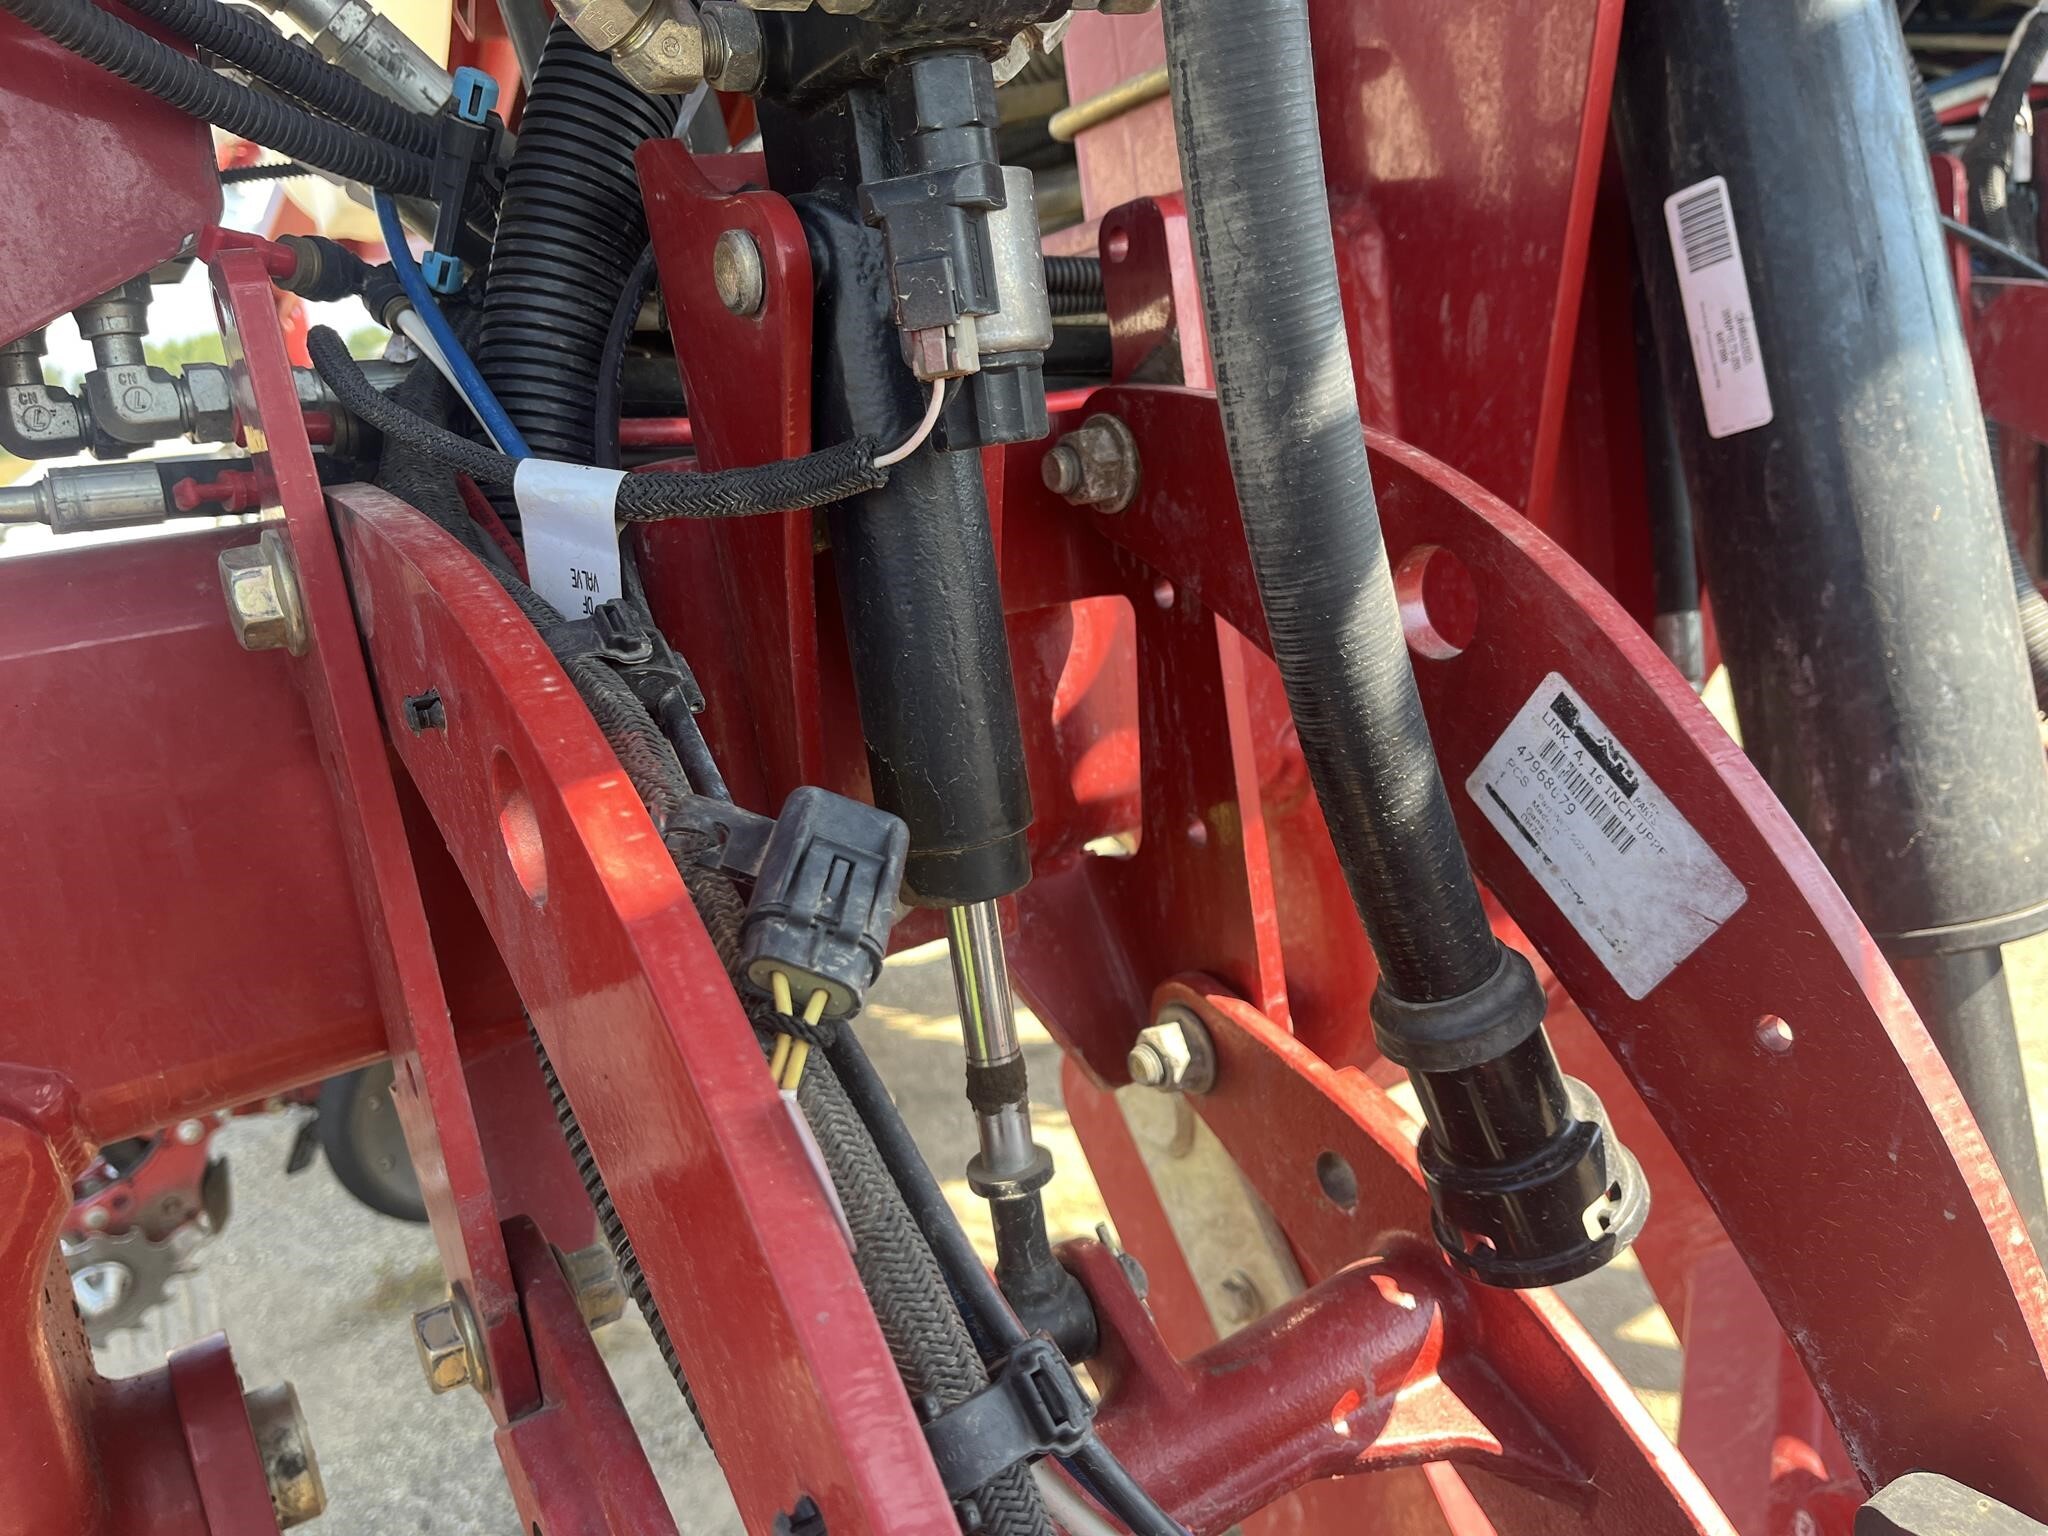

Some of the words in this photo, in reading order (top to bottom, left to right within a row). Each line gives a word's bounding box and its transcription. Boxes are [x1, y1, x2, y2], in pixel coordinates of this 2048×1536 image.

[118, 372, 138, 385] CN
[18, 391, 38, 405] CN
[569, 567, 599, 593] VALVE
[1505, 758, 1530, 788] PCS
[1541, 712, 1572, 749] LINK,
[1574, 749, 1589, 766] A,
[1589, 768, 1605, 785] 16
[1605, 786, 1637, 822] INCH
